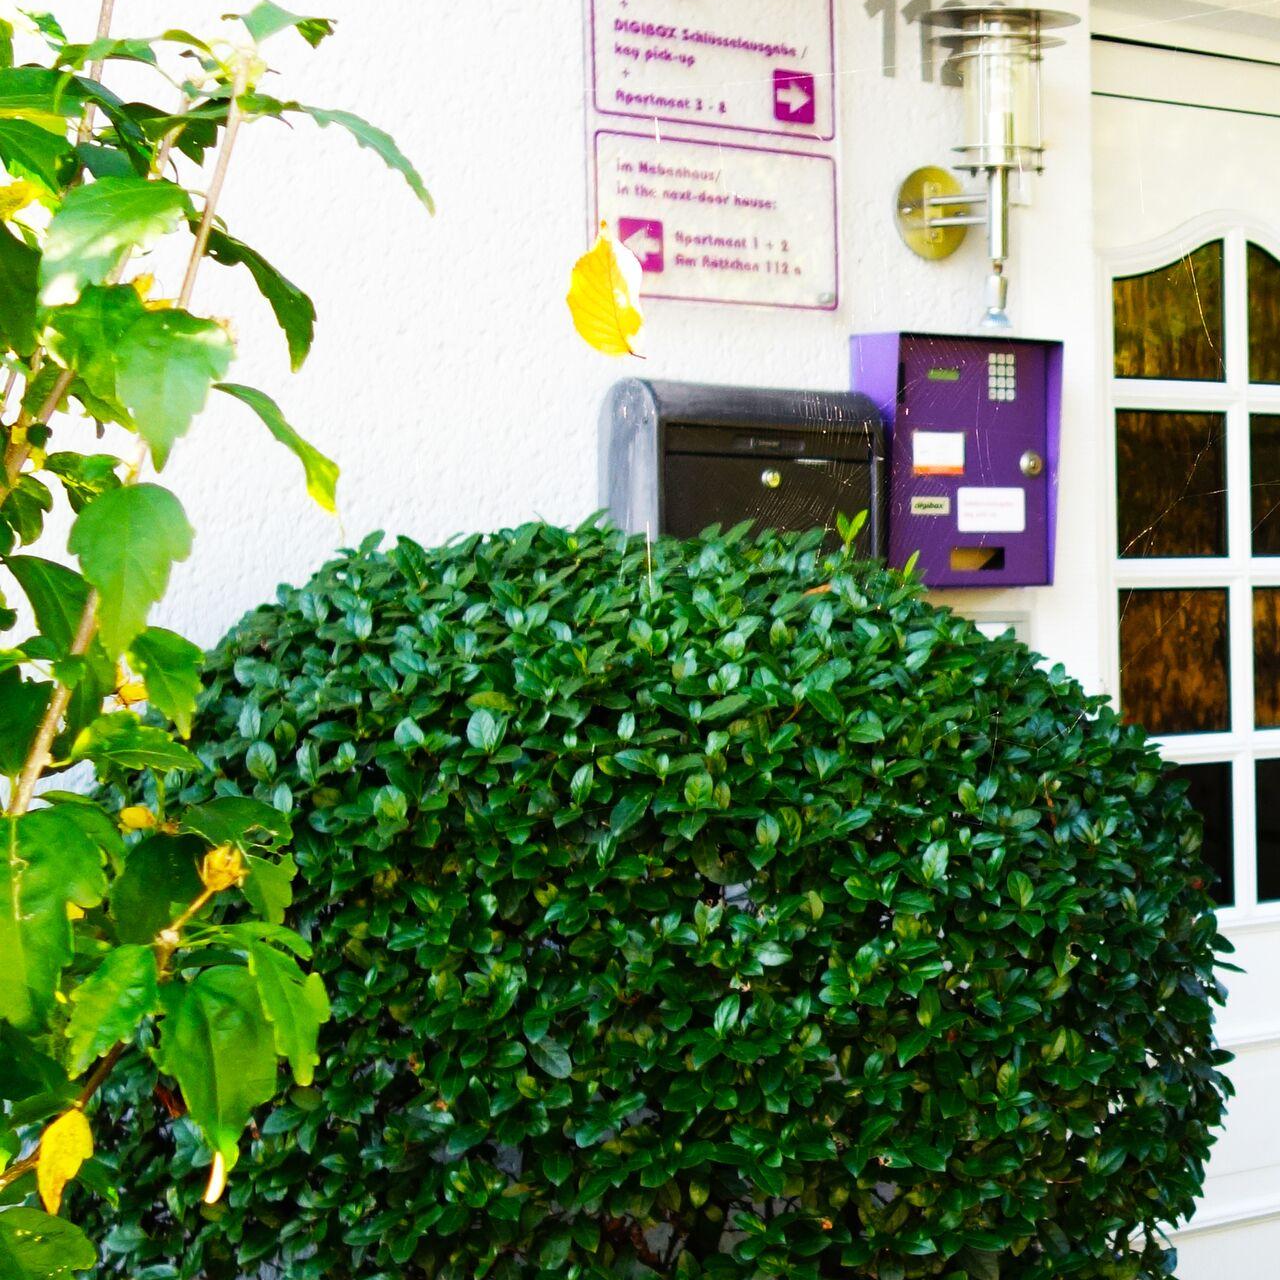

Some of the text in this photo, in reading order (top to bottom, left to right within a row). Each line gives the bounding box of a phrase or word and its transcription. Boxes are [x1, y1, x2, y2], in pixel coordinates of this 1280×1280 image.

[614, 42, 696, 68] key pick-up
[616, 157, 633, 173] im
[616, 180, 630, 196] in
[634, 184, 657, 199] the
[662, 189, 730, 206] next-door
